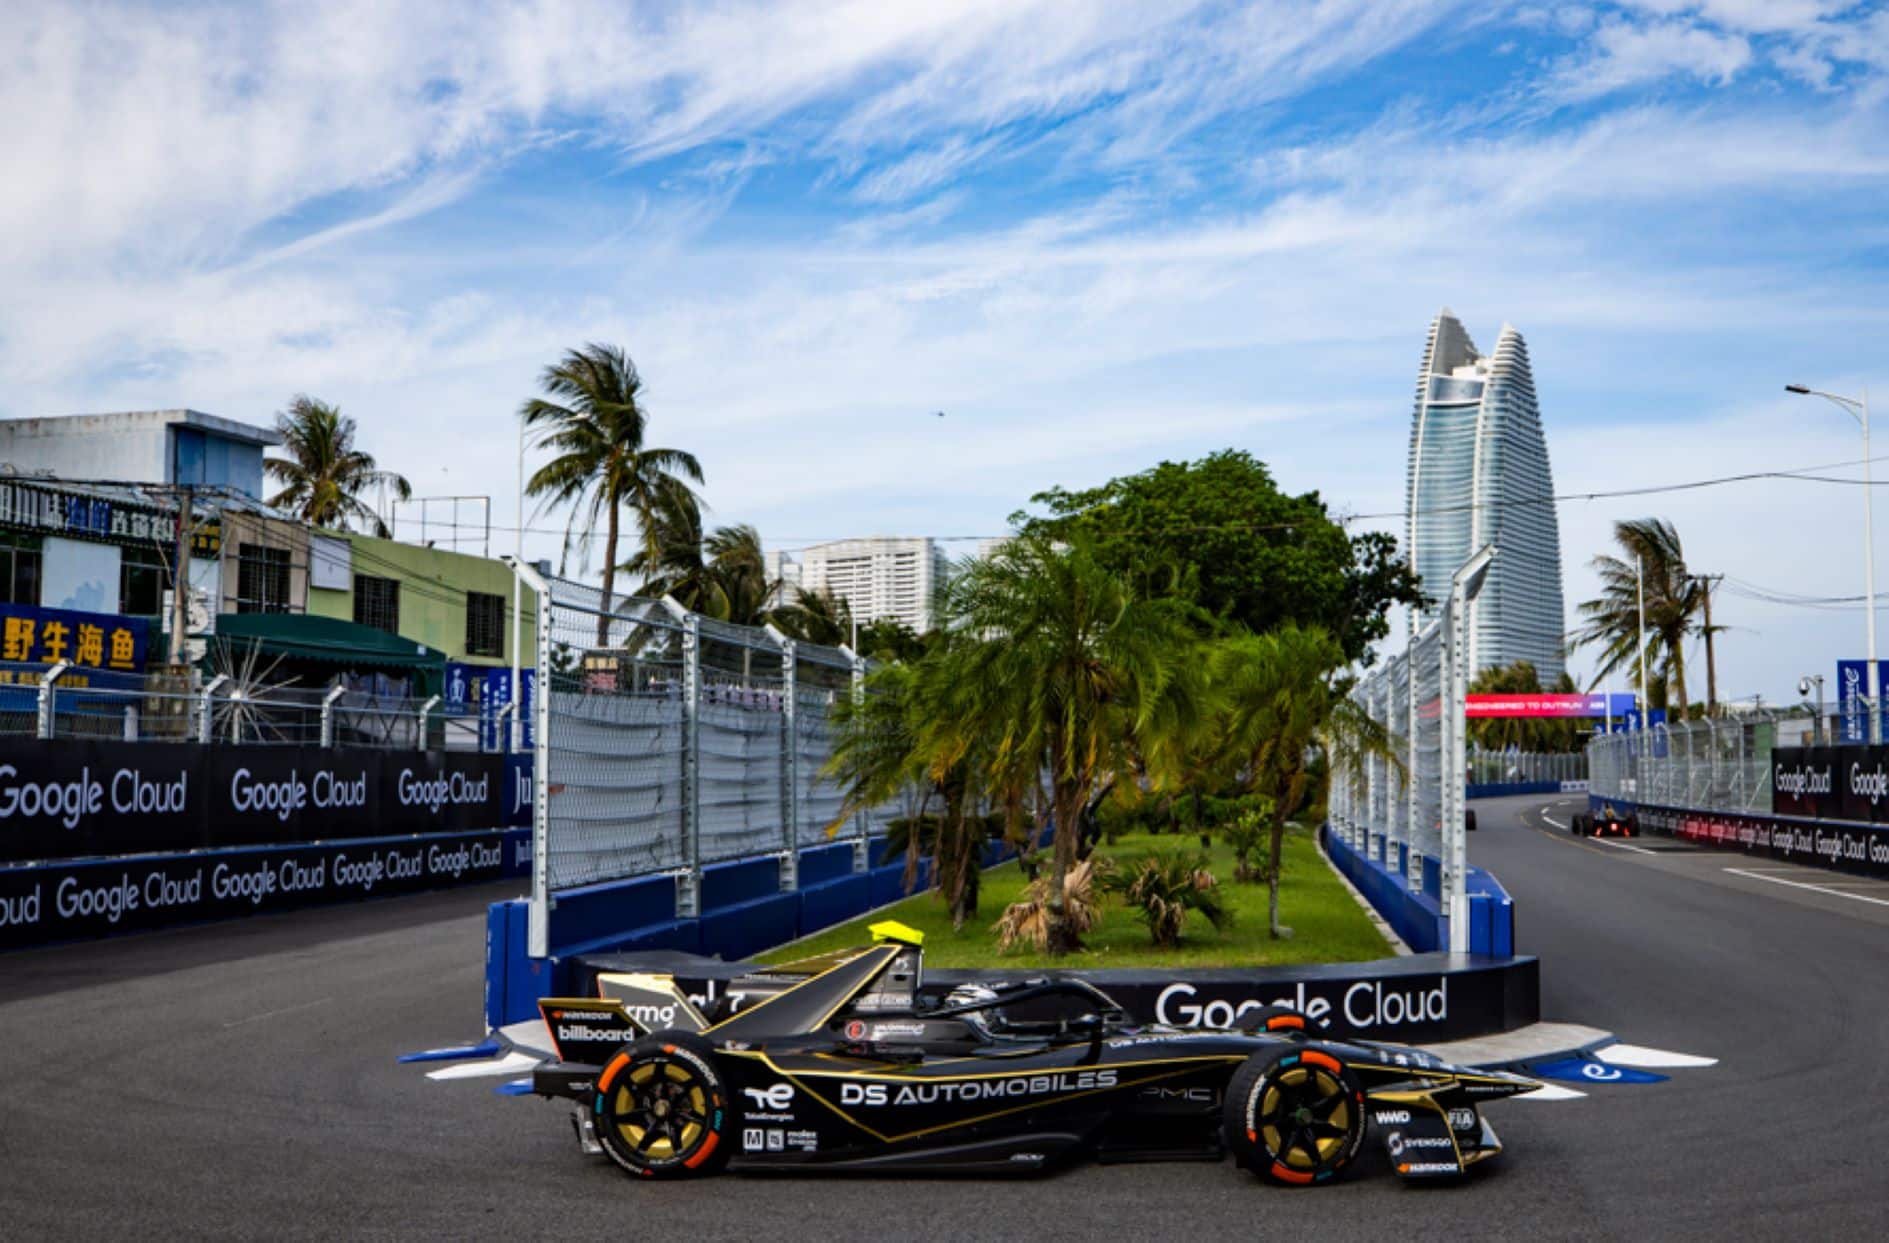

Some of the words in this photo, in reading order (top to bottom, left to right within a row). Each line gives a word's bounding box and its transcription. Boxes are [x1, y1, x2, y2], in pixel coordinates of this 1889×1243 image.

[3, 616, 136, 669] 野生海鱼
[0, 764, 104, 829] Google
[111, 768, 187, 814] Cloud
[231, 767, 306, 821] Google
[312, 770, 366, 809] Cloud
[399, 767, 449, 815] Google
[450, 771, 488, 804] Cloud
[0, 883, 41, 927] oud
[56, 873, 139, 923] Google
[144, 870, 201, 908] Cloud
[212, 860, 276, 903] Google
[279, 859, 325, 893] Cloud
[333, 852, 383, 894] Google
[385, 850, 422, 883] Cloud
[428, 844, 470, 879] Google
[471, 841, 501, 869] Cloud
[1344, 976, 1447, 1027] Cloud
[558, 1024, 634, 1042] billboard
[840, 1083, 889, 1106] DS
[894, 1070, 1118, 1106] AUTOMOBILES
[1375, 1110, 1411, 1124] WWD
